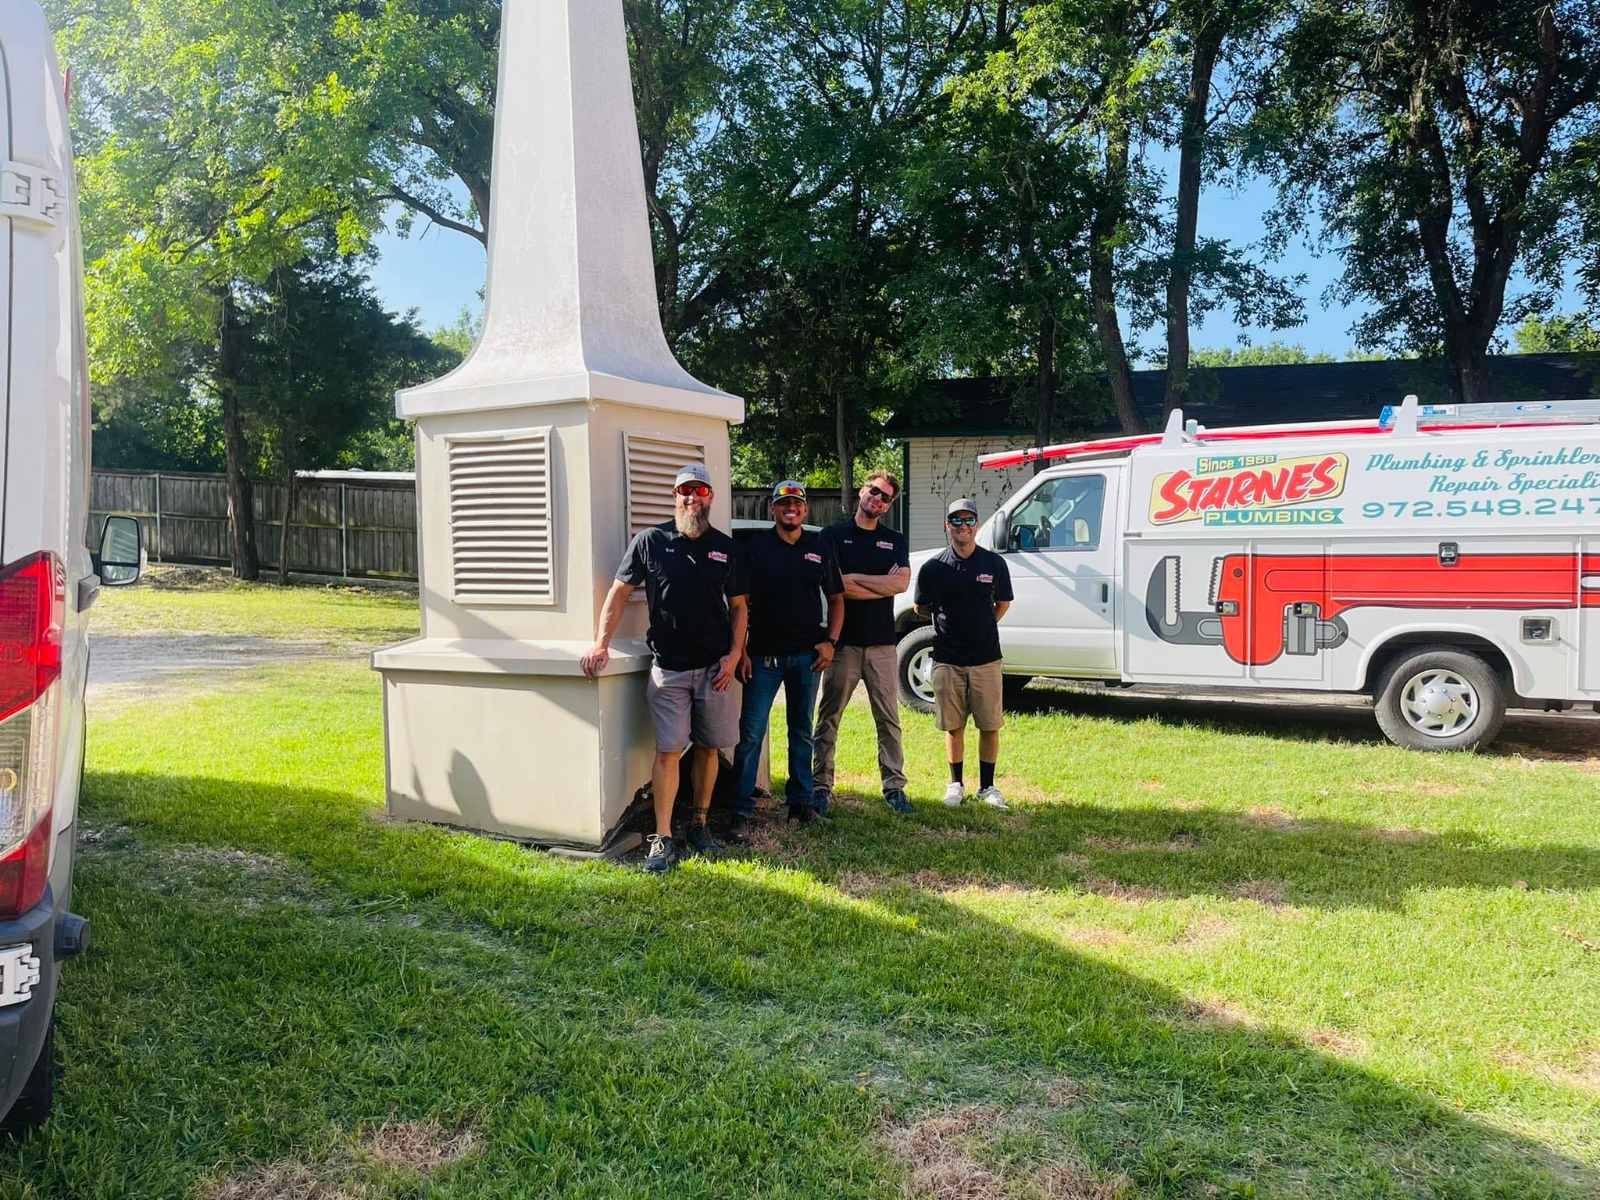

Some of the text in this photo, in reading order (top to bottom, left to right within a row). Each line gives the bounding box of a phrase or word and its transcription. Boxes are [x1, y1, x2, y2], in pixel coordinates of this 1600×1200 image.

[1199, 458, 1234, 473] Since
[1365, 451, 1468, 472] Plumbing
[1472, 449, 1489, 467] &
[1153, 456, 1338, 520] STARNES
[1428, 474, 1500, 496] Repair
[1205, 509, 1336, 525] PLUMBING
